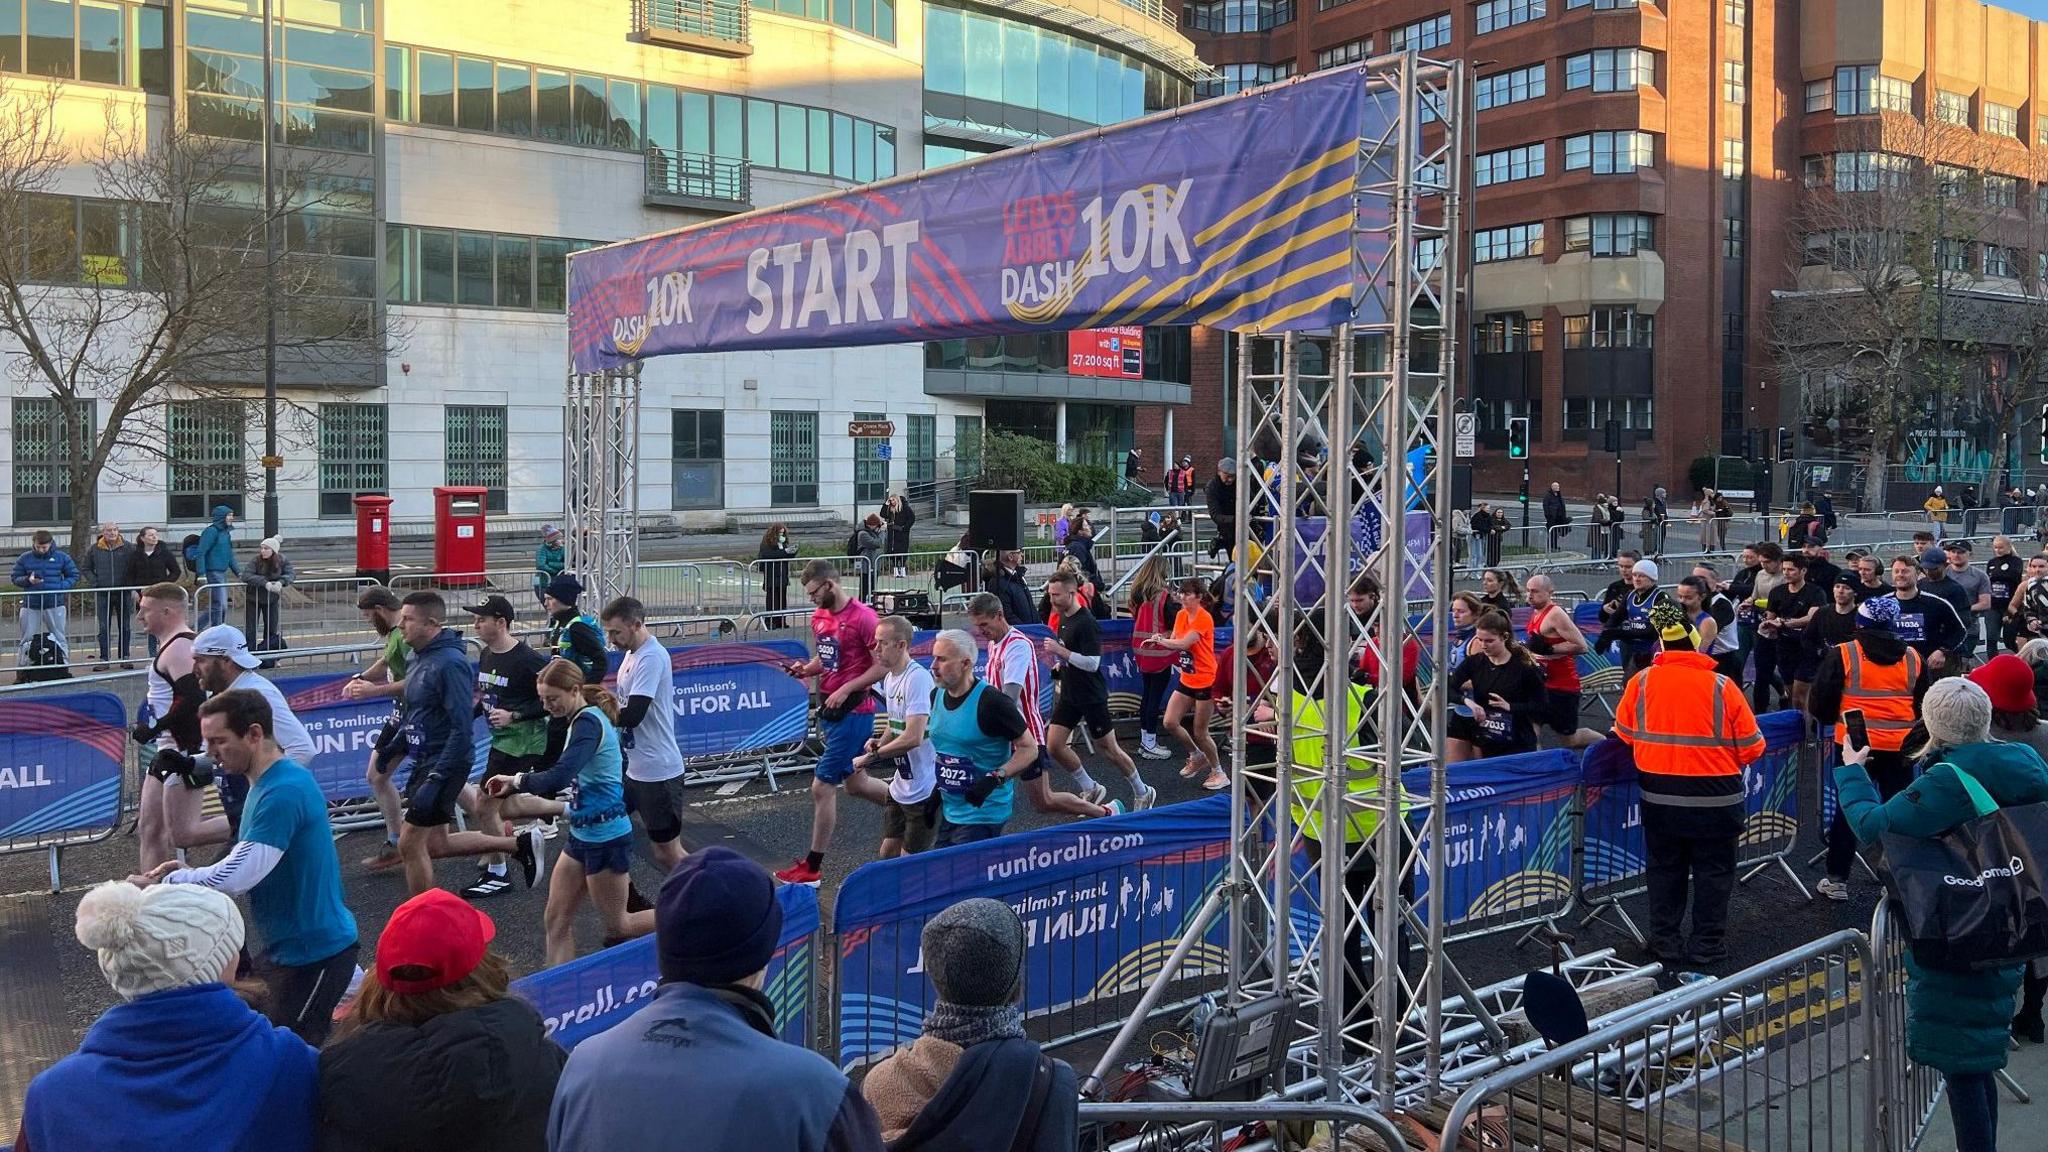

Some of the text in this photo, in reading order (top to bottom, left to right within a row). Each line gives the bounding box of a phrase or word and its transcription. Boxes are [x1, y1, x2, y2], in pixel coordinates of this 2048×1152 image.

[1081, 178, 1194, 277] 10K
[647, 271, 694, 327] 10K
[745, 219, 919, 335] START
[1001, 260, 1075, 305] DASH
[613, 315, 647, 342] DASH
[690, 694, 731, 716] FOR
[737, 691, 771, 711] ALL
[352, 729, 384, 751] FO
[0, 765, 51, 790] ALL
[940, 767, 967, 780] 2072
[987, 833, 1144, 881] runforall.com
[544, 977, 662, 1039] orall.co
